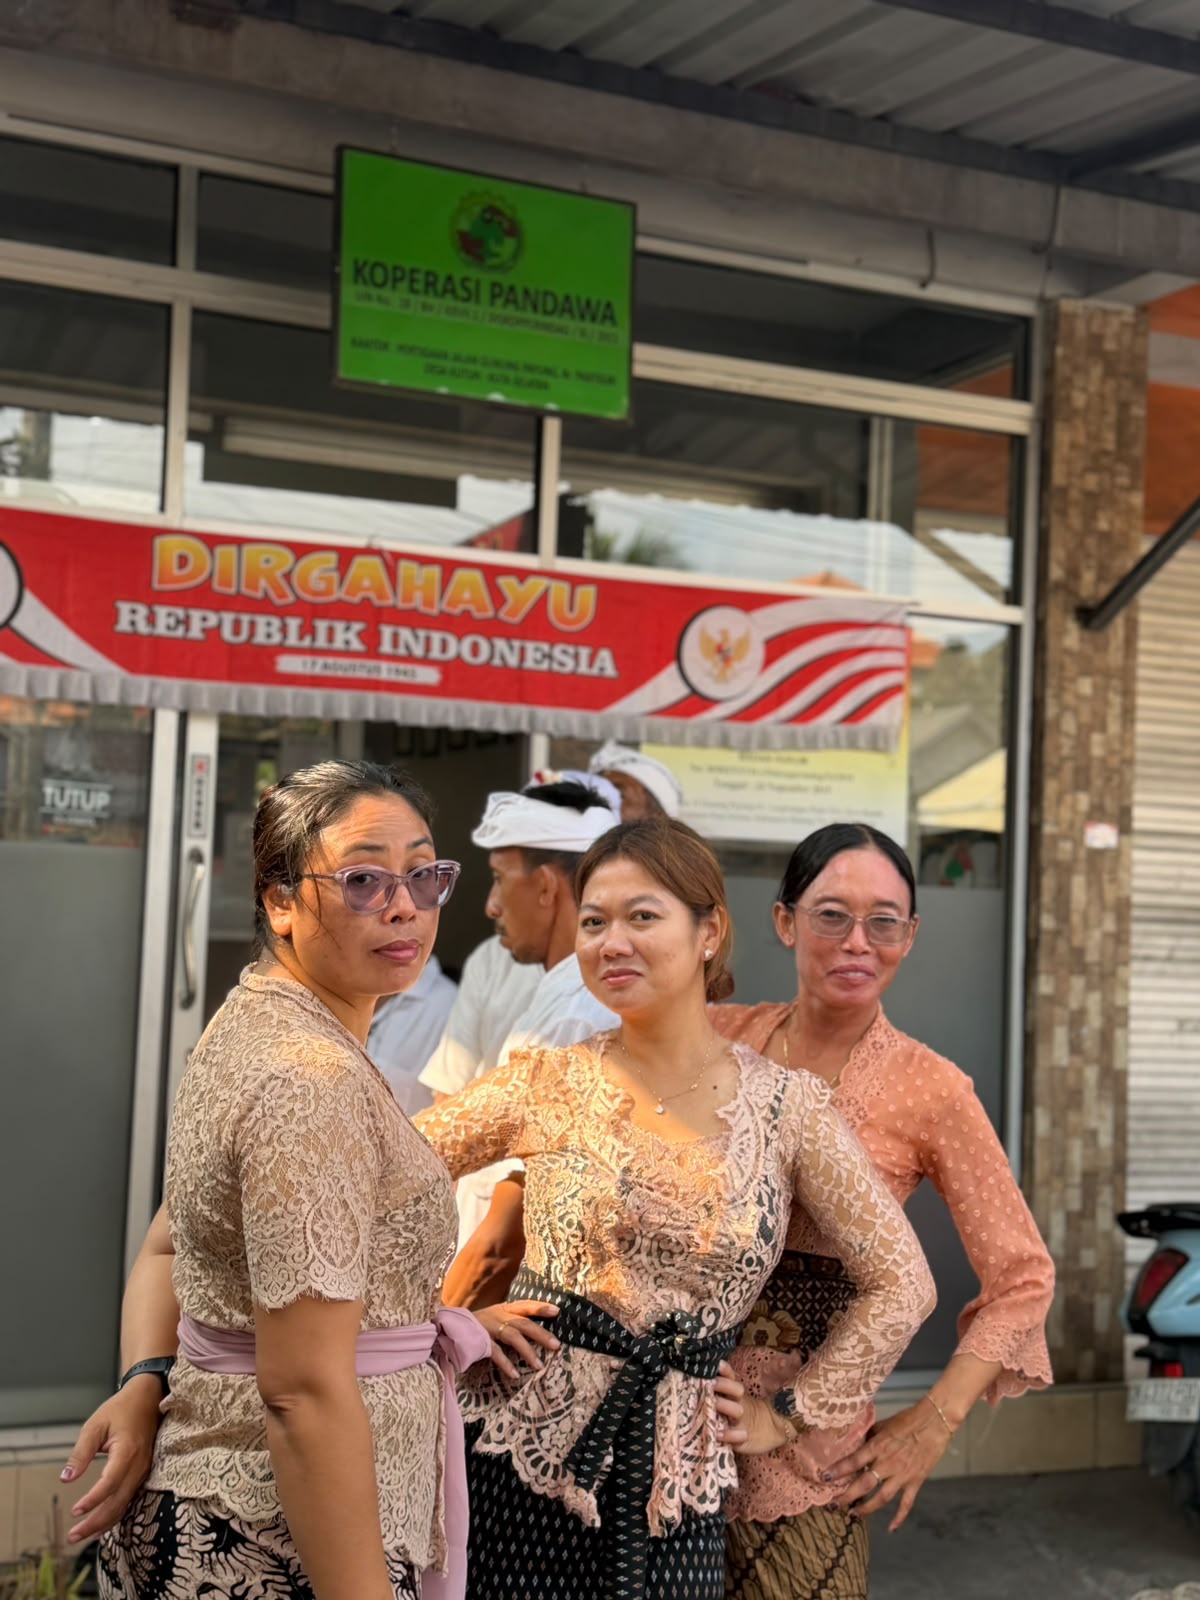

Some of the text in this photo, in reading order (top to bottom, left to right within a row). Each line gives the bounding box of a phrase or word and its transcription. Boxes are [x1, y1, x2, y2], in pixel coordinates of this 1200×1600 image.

[352, 258, 481, 304] KOPERASI
[489, 281, 617, 327] PANDAWA
[151, 534, 597, 632] DIRGAHAYU
[113, 600, 619, 679] REPUBLIK INDONESIA
[42, 785, 112, 811] TUTUP
